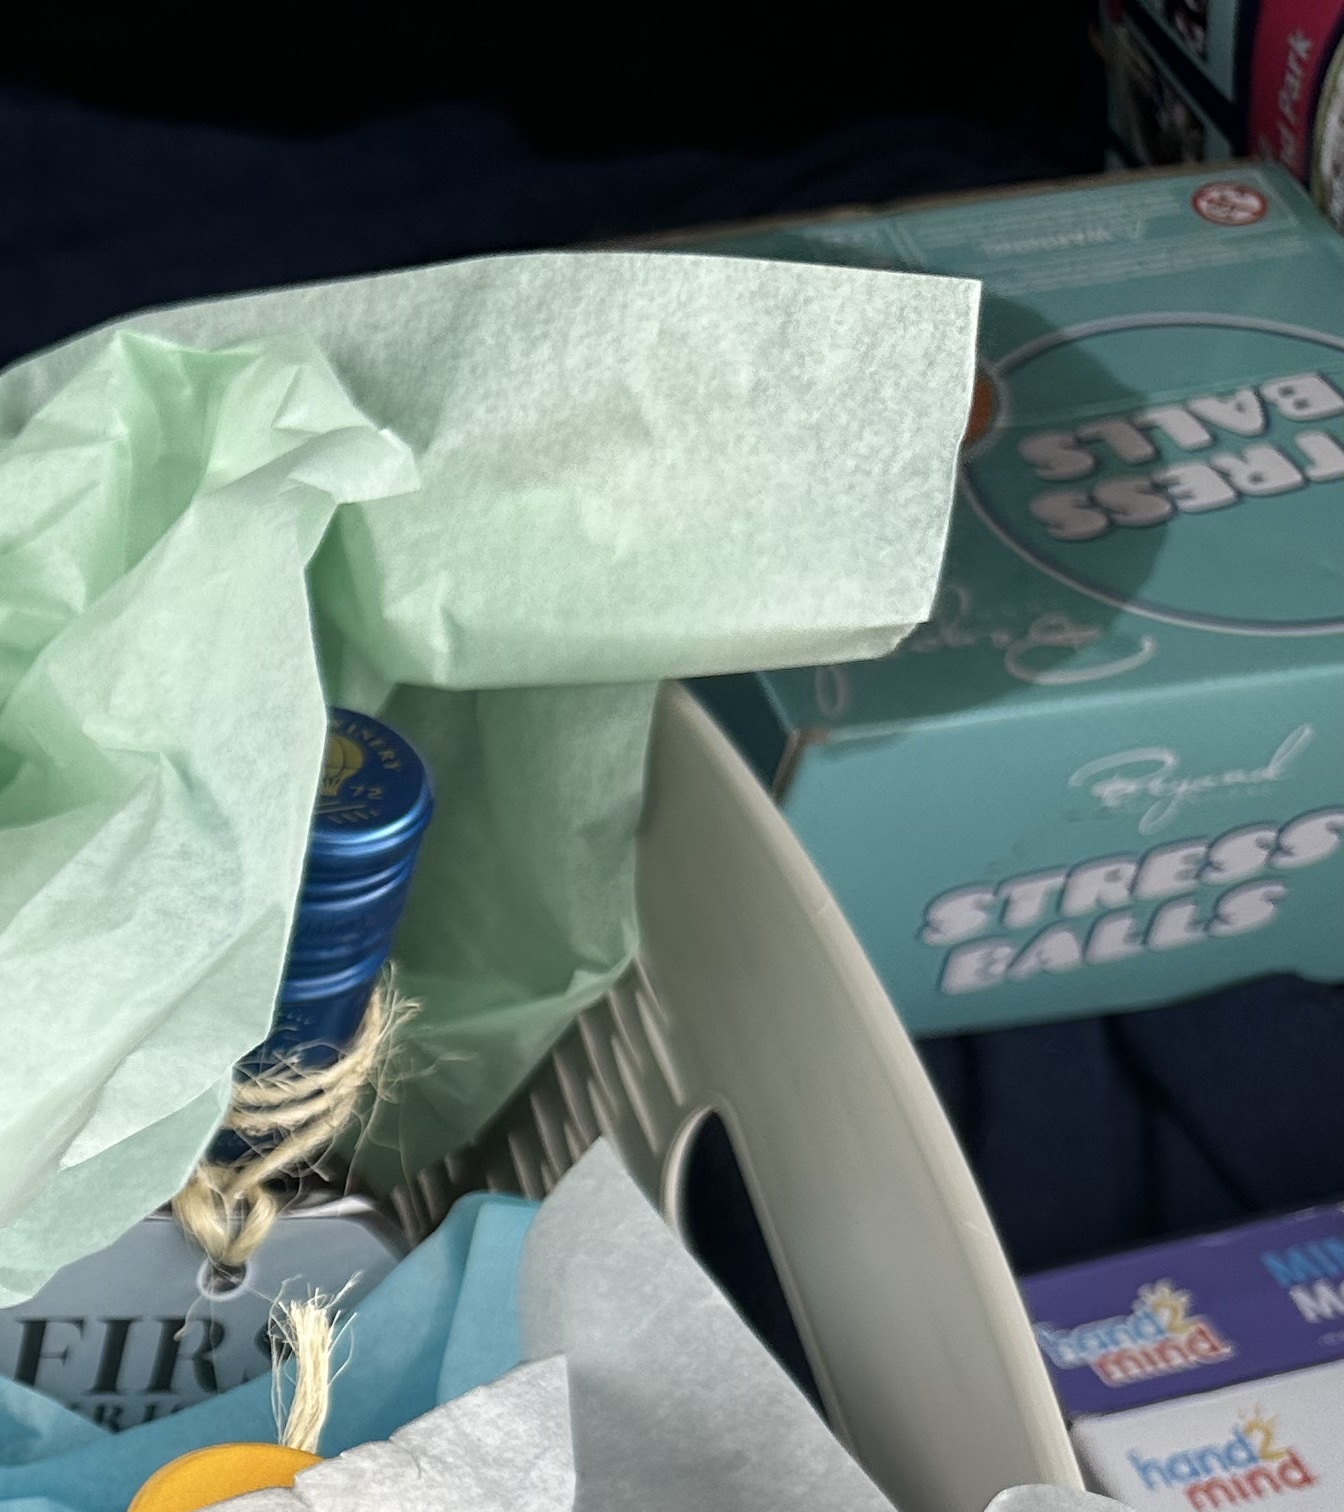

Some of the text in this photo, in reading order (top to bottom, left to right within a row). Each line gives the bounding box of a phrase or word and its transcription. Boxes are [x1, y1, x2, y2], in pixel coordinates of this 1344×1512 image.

[1016, 371, 1344, 482] BALLS
[1029, 428, 1344, 541] TRESS
[920, 804, 1344, 946] STRESS
[938, 879, 1289, 995] BALLS
